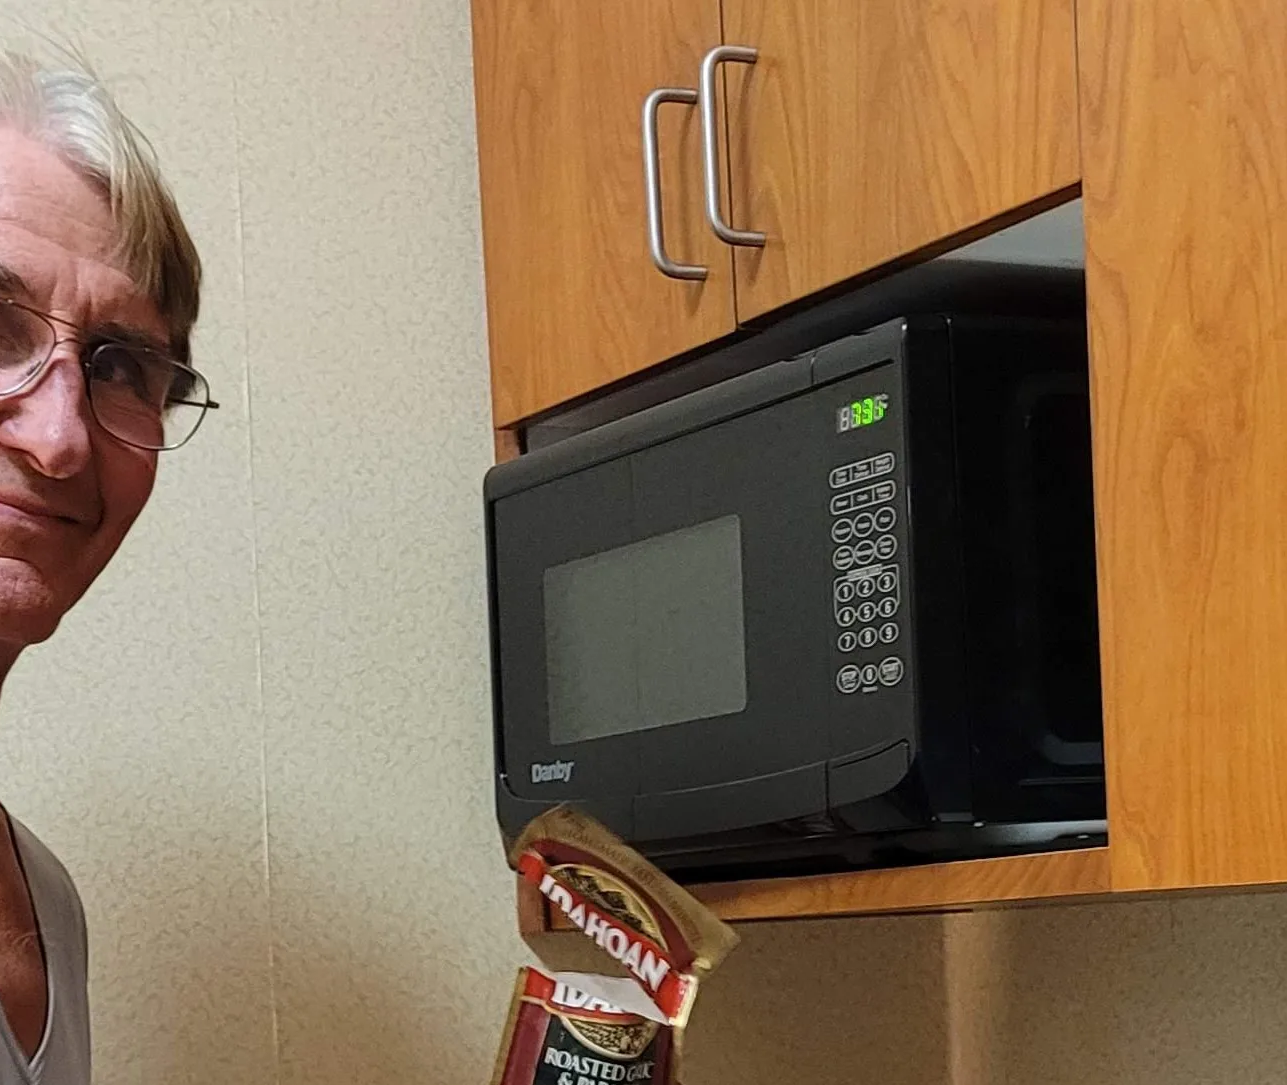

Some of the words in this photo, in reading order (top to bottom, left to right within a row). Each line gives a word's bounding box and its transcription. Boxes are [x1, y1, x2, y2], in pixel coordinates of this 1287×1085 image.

[843, 586, 849, 598] 1
[862, 580, 870, 594] 2
[882, 575, 891, 589] 3
[843, 610, 851, 622] 4
[864, 605, 871, 619] 5
[884, 601, 892, 614] 6
[844, 635, 852, 648] 7
[864, 630, 872, 643] 8
[885, 626, 893, 640] 9
[866, 668, 873, 681] 0
[531, 760, 575, 783] Danby
[544, 1047, 625, 1082] ROASTED
